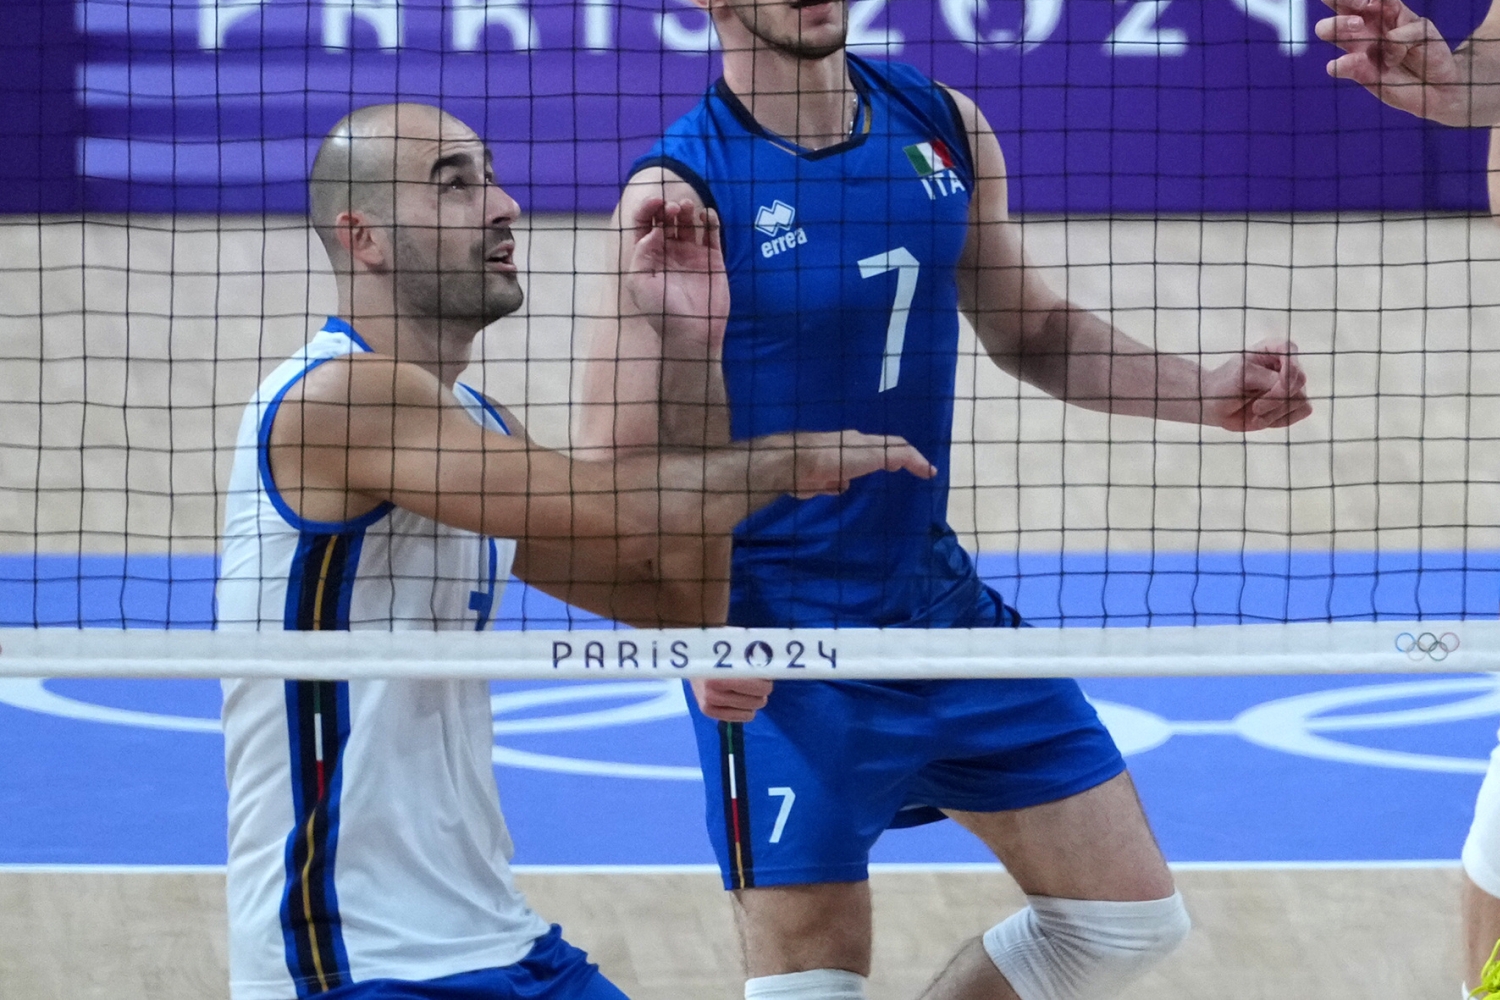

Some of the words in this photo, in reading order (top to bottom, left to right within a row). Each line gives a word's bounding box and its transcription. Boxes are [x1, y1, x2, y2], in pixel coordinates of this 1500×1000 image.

[920, 169, 966, 200] ITA
[761, 227, 808, 258] errea
[857, 246, 920, 393] 7
[712, 640, 837, 669] 2024
[767, 786, 796, 844] 7
